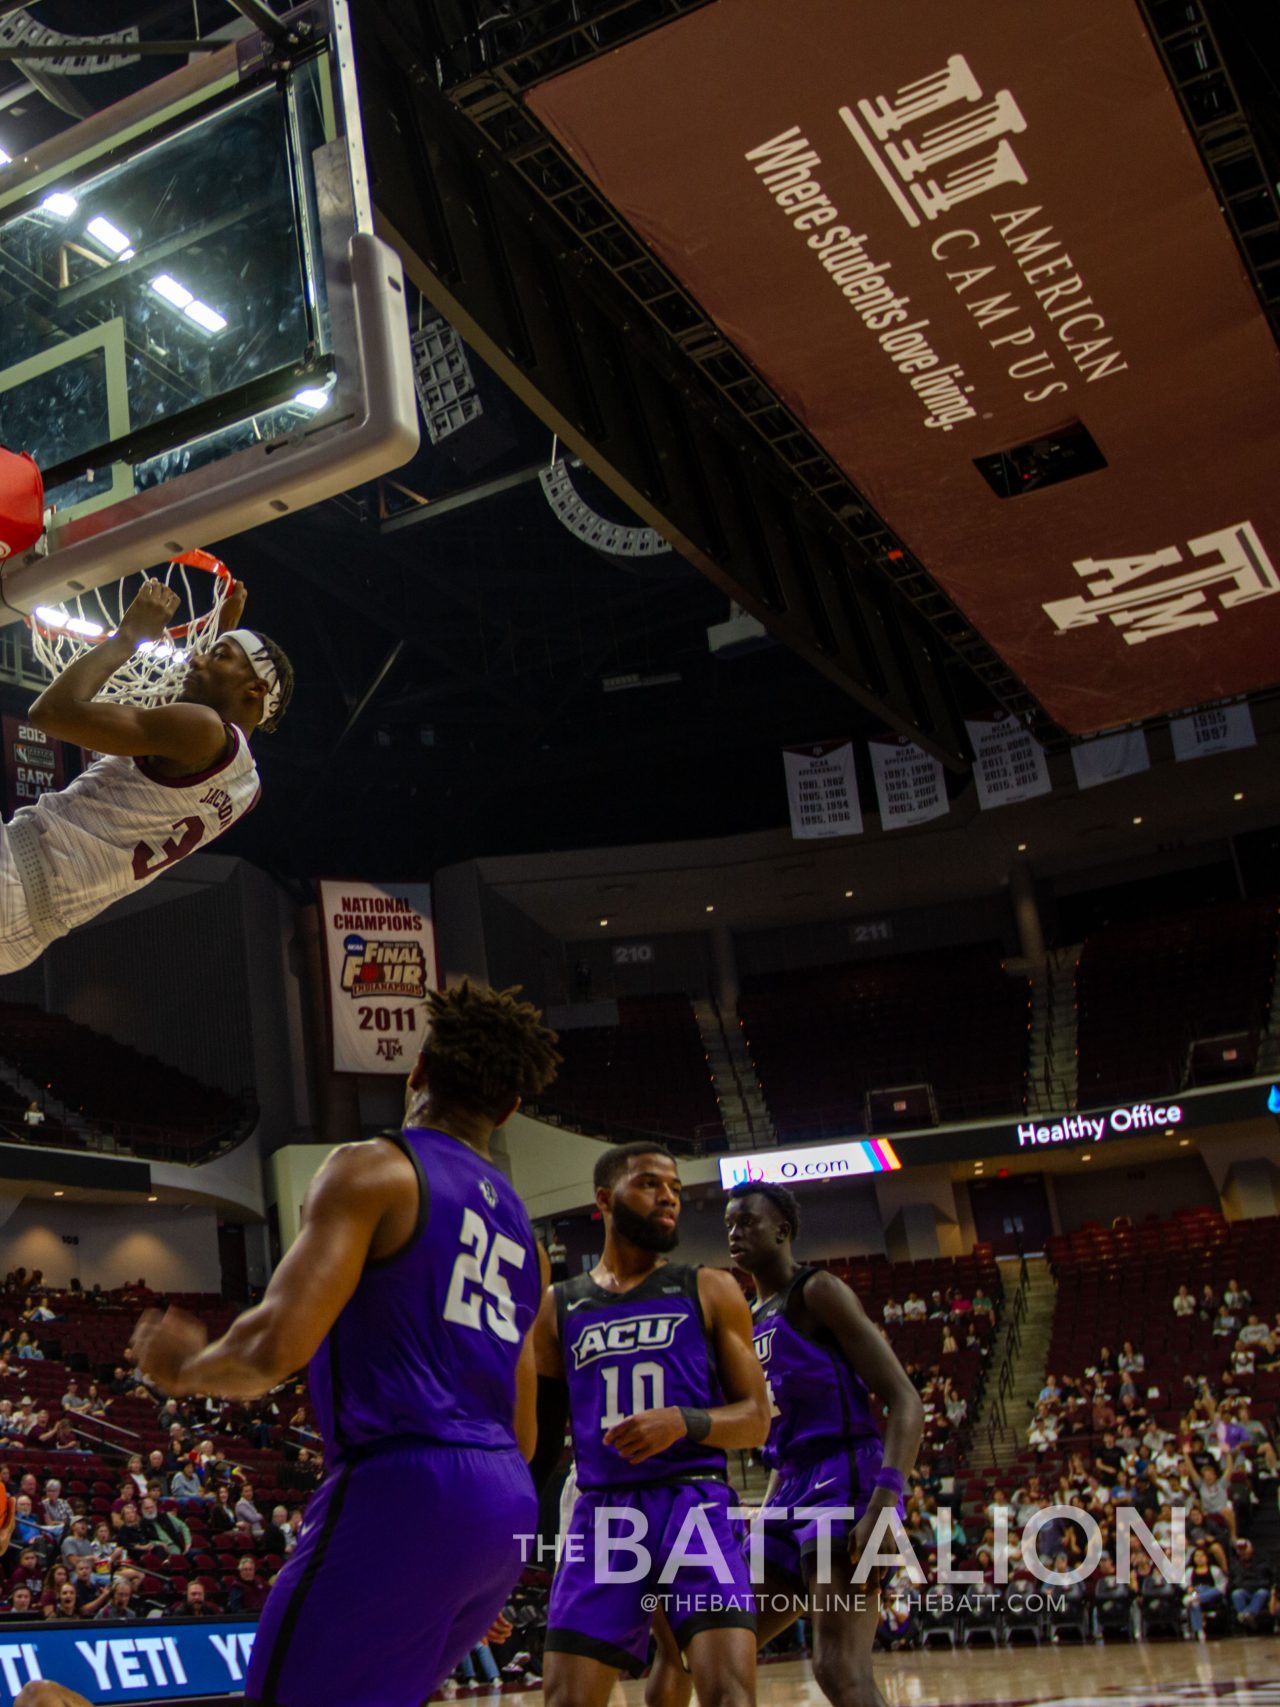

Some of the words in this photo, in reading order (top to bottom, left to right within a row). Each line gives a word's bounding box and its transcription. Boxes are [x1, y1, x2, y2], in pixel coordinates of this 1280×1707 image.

[744, 125, 838, 231] Where
[807, 225, 910, 329] students
[878, 319, 939, 374] love
[910, 364, 976, 431] living.
[991, 205, 1128, 383] AMERICAN
[931, 229, 1068, 402] CAMPUS
[18, 725, 47, 743] 2013
[17, 767, 54, 787] GARY
[341, 896, 412, 913] NATIONAL
[333, 913, 423, 931] CHAMPIONS
[854, 923, 889, 942] 211
[364, 942, 421, 964] FINAL
[615, 945, 653, 963] 210
[358, 1006, 416, 1032] 2011
[1017, 1114, 1105, 1146] Healthy
[1110, 1104, 1183, 1132] Office
[443, 1207, 526, 1343] 25
[579, 1319, 673, 1361] ACU
[600, 1361, 665, 1430] 10
[75, 1636, 188, 1691] YETI
